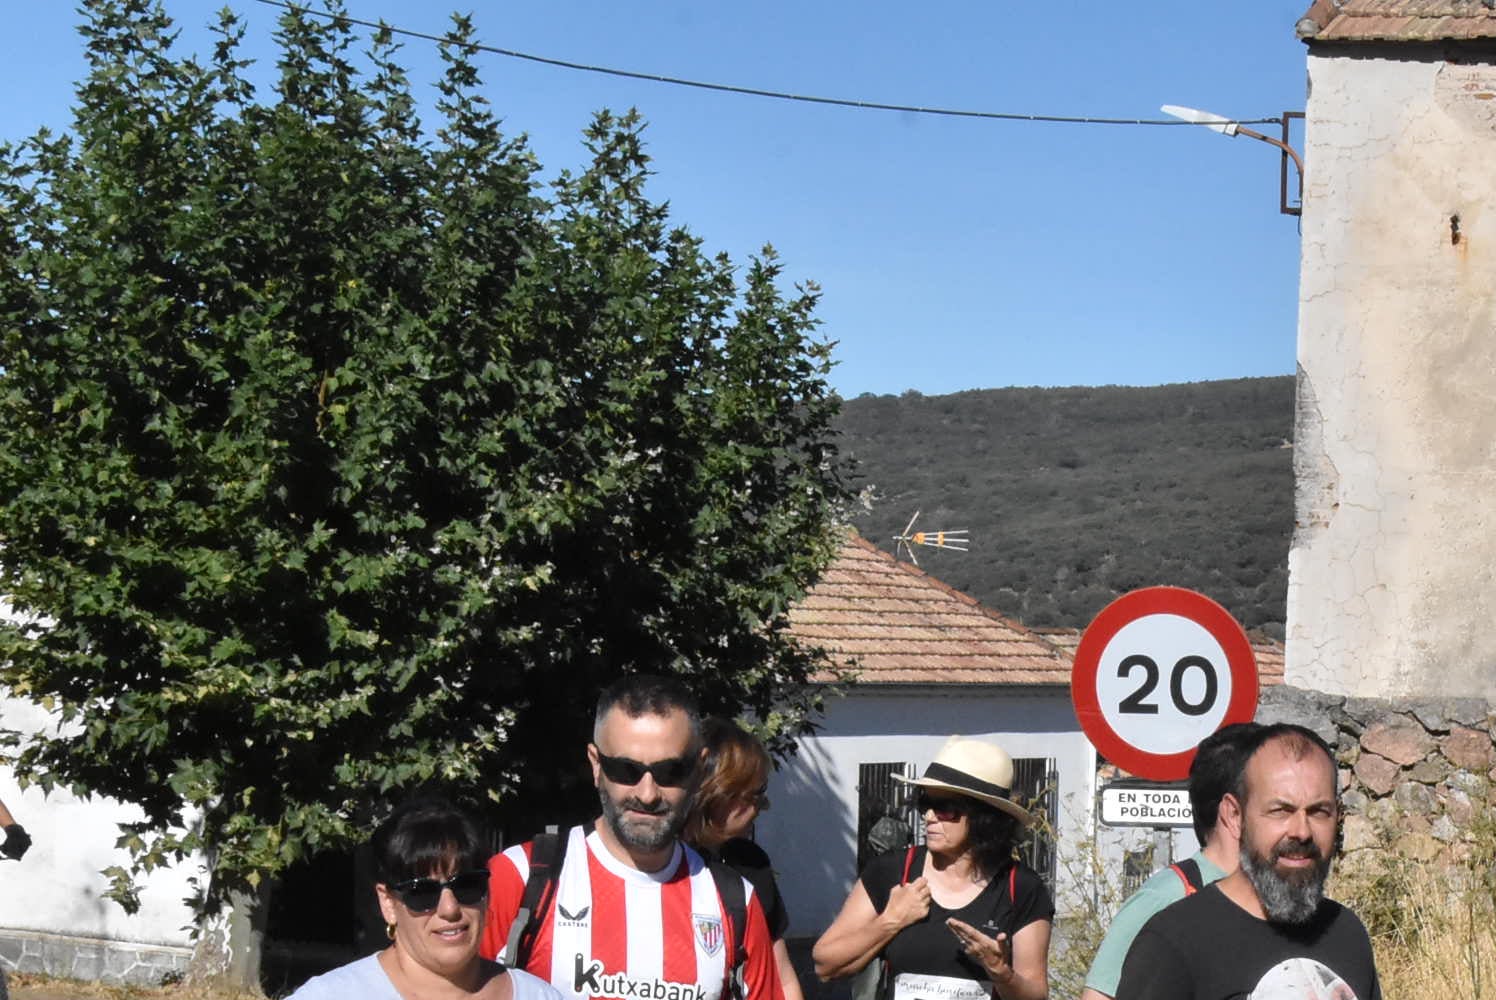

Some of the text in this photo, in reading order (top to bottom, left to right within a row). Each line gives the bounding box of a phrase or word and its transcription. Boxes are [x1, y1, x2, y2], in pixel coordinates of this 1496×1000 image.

[1117, 654, 1218, 716] 20
[1118, 793, 1137, 803] EN
[1143, 793, 1181, 804] TODA
[1120, 804, 1193, 818] POBLACIÓ
